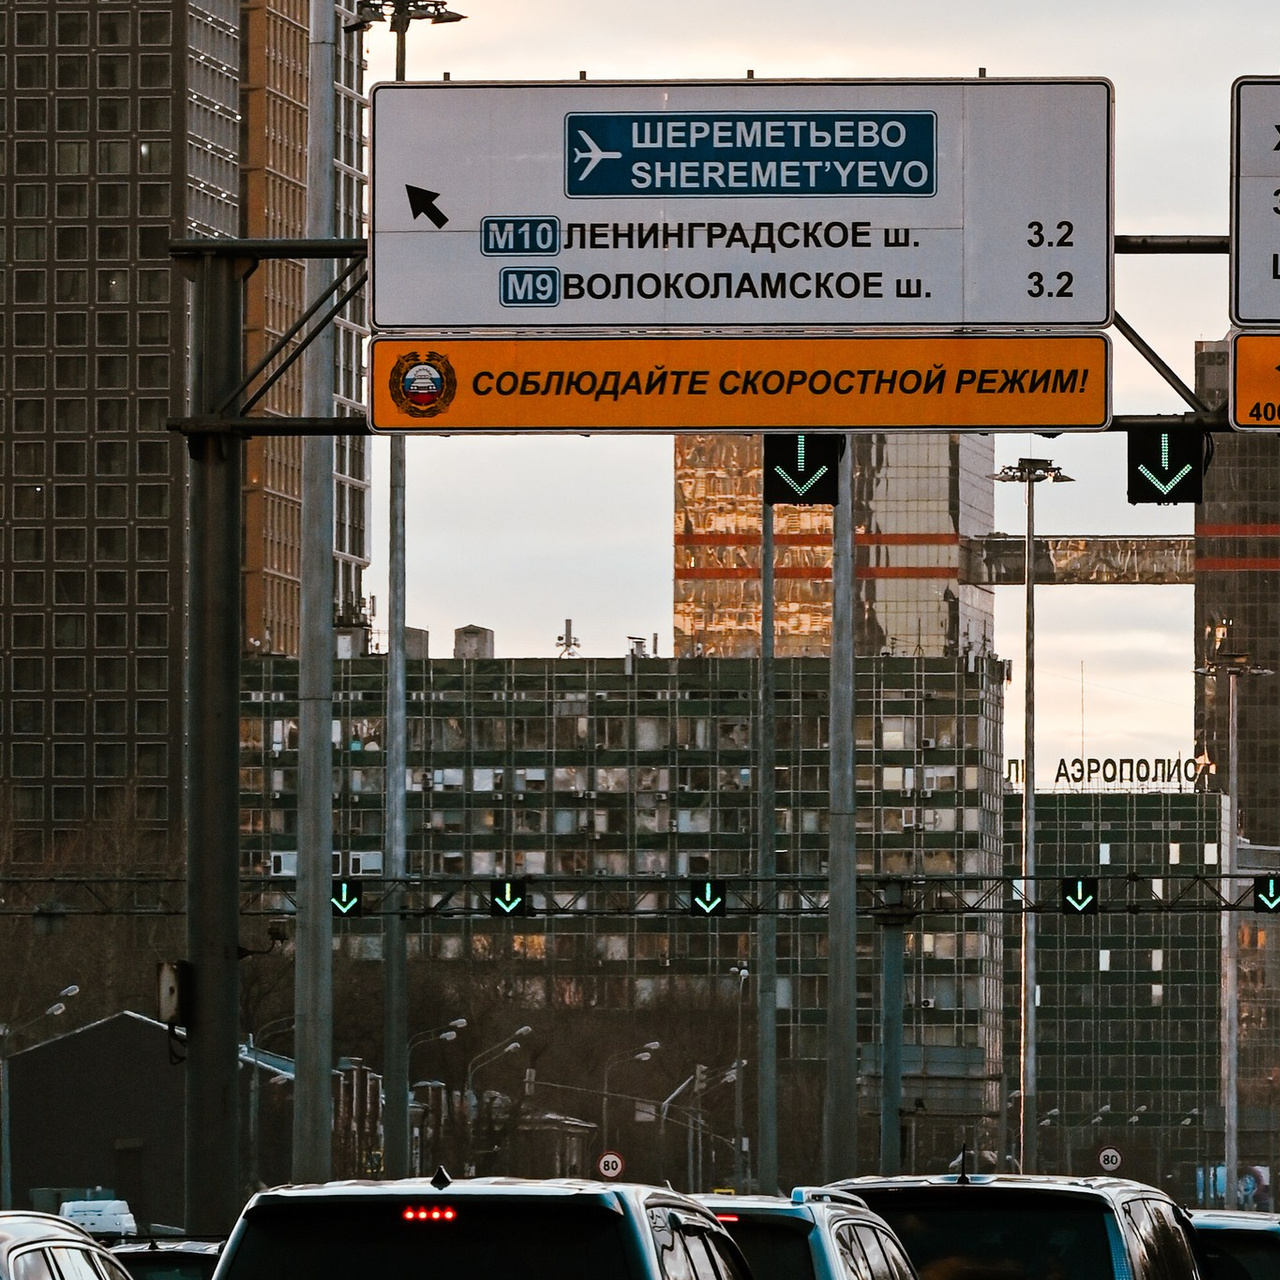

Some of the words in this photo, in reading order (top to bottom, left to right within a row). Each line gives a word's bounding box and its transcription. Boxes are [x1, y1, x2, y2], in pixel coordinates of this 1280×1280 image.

[633, 121, 906, 147] ШЕРЕМЕТЬЕВО
[564, 222, 871, 253] ЛЕНИНГРАДСКОЕ
[884, 229, 919, 247] ш.
[1028, 221, 1073, 247] 3.2
[564, 272, 883, 299] ВОЛОКОЛАМСКОЕ
[896, 279, 931, 298] ш.
[1028, 272, 1073, 297] 3.2
[473, 365, 709, 401] СОБЛЮДАЙТЕ
[719, 364, 946, 395] СКОРОСТНОЙ
[955, 369, 1088, 393] РЕЖИМ!
[1055, 758, 1198, 783] АЭРОПОЛИС
[604, 1160, 618, 1171] 80
[1103, 1154, 1118, 1165] 80
